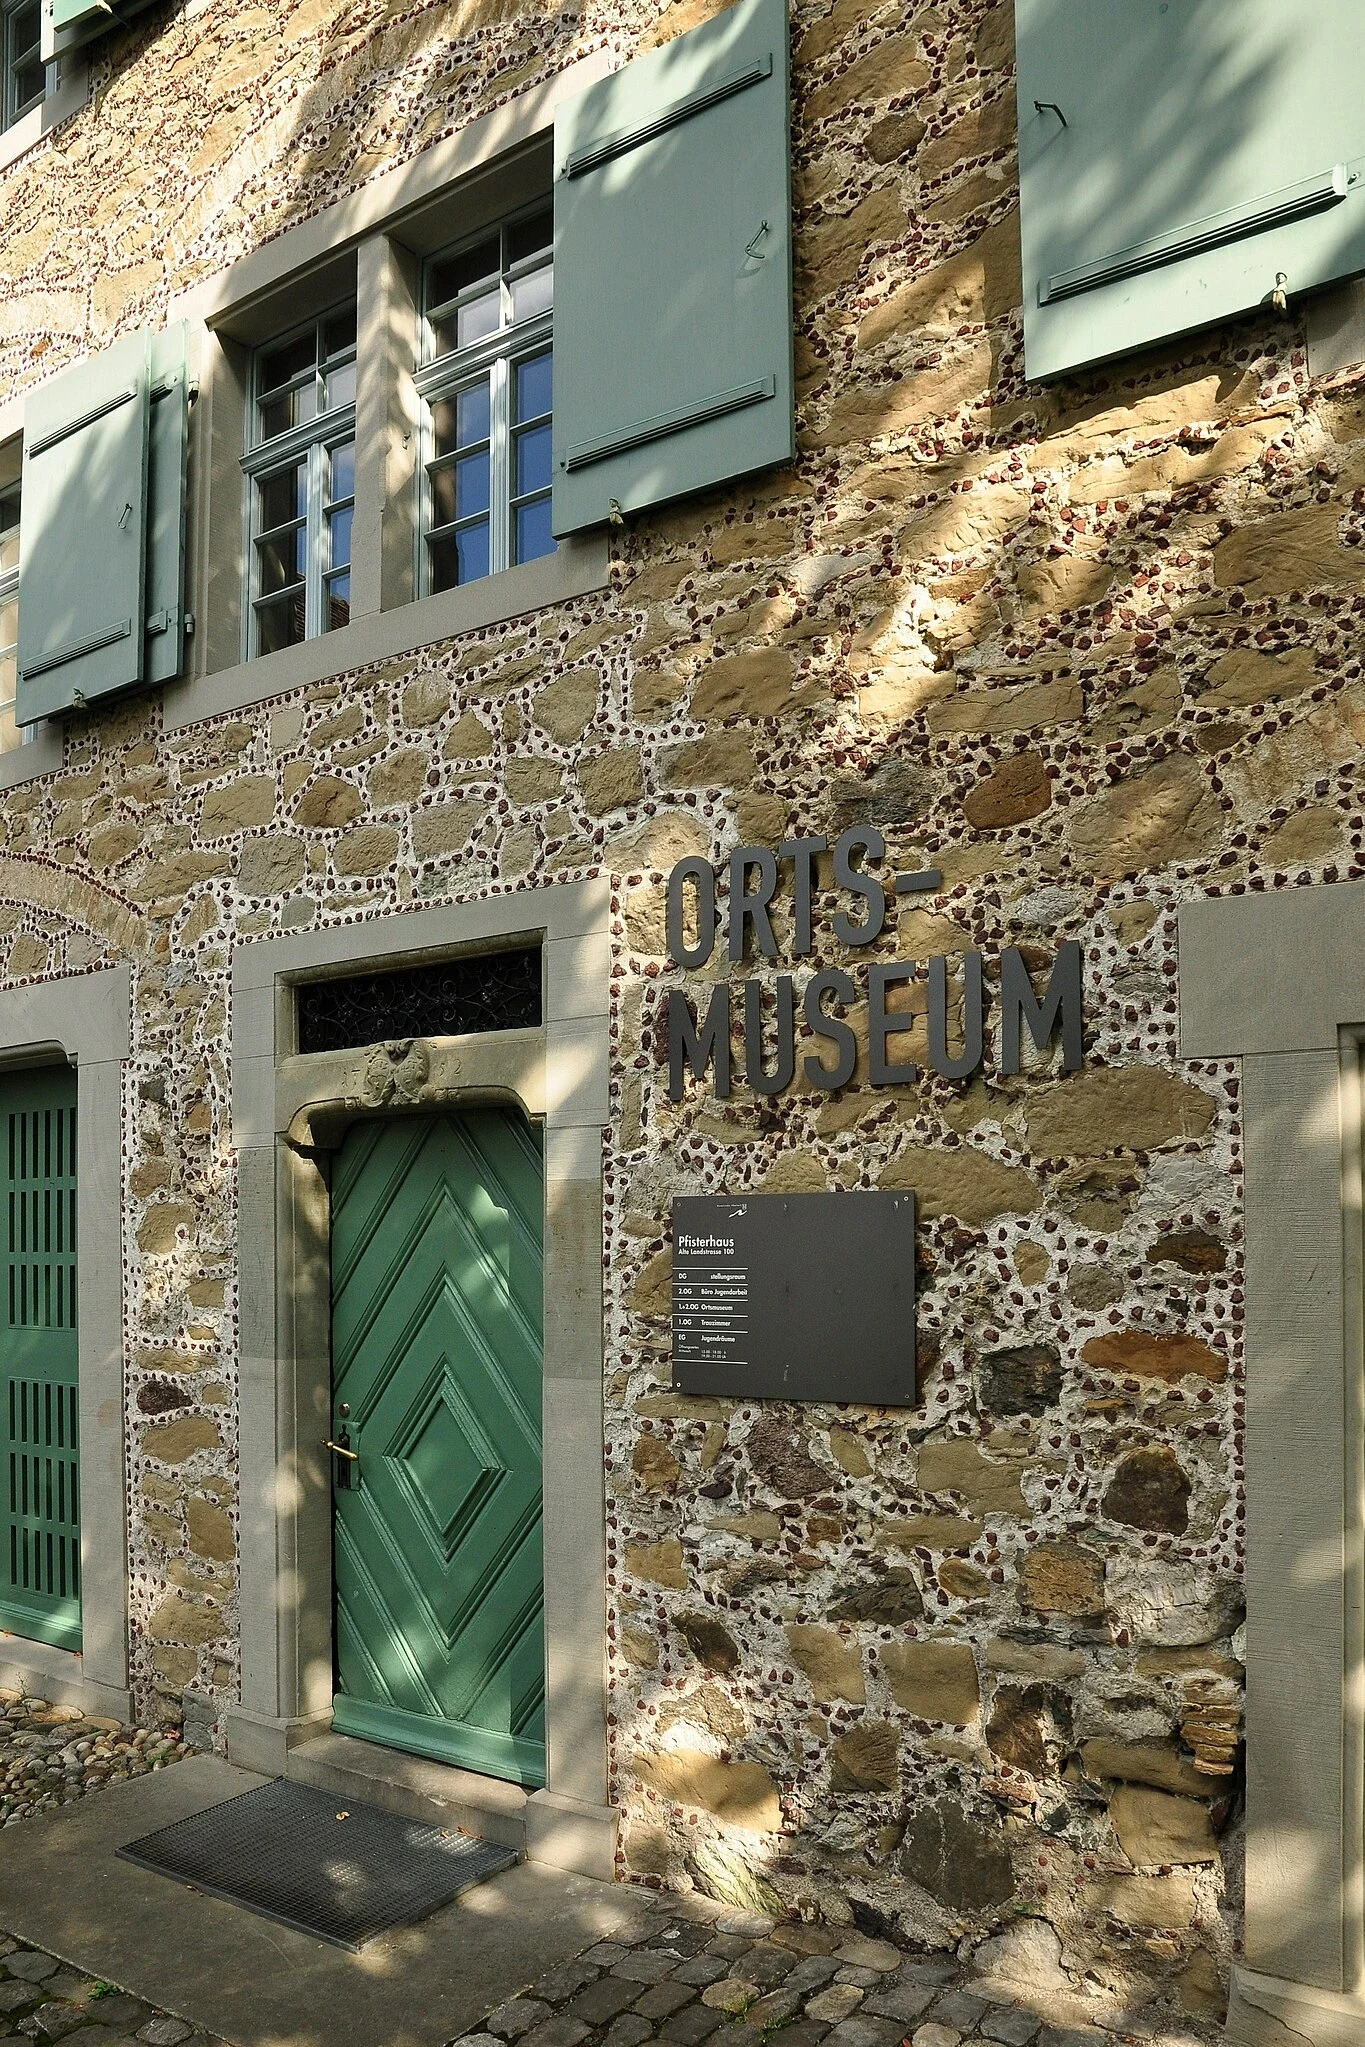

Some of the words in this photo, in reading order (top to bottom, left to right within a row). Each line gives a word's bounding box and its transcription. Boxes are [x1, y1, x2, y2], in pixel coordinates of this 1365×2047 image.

[668, 824, 942, 968] ORTS-
[668, 940, 1083, 1101] MUSEUM
[678, 1234, 735, 1247] Pfisterhaus
[714, 1288, 748, 1297] Jugendarbeit
[700, 1303, 733, 1311] Ortsmuseum
[678, 1318, 692, 1326] 1.OG
[701, 1319, 731, 1327] Trauzimmer
[700, 1334, 736, 1343] Jugendräume
